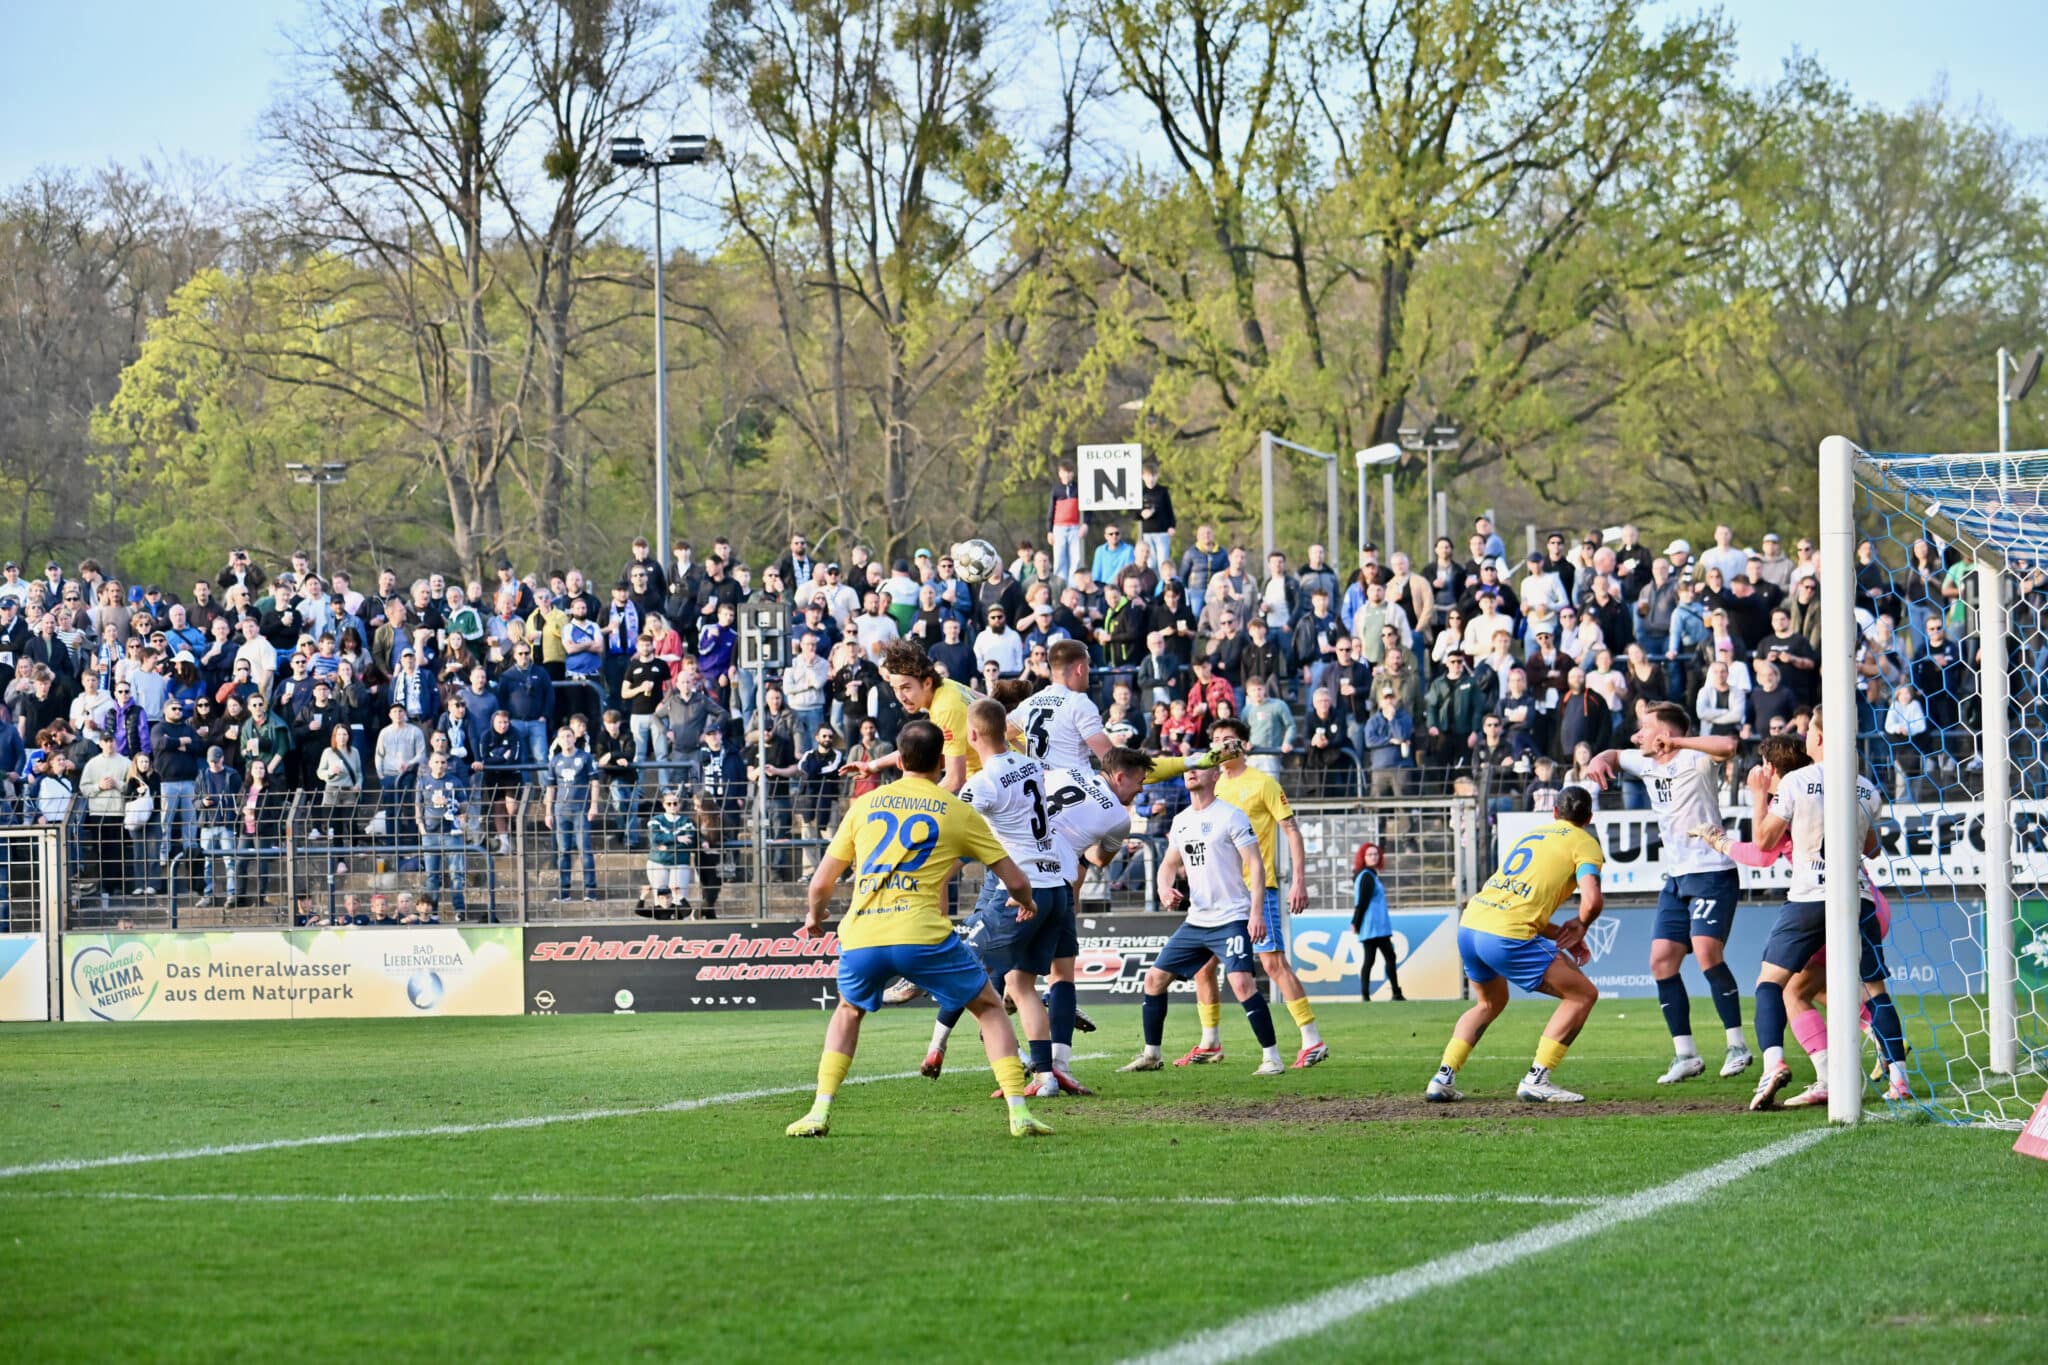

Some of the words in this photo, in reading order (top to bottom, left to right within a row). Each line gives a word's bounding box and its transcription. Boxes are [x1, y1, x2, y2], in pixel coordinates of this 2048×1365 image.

[1086, 449, 1132, 460] BLOCK
[1093, 467, 1127, 503] N
[869, 795, 948, 816] LUCKENWALDE
[1023, 778, 1049, 841] 3
[860, 810, 940, 877] 29
[1189, 854, 1206, 867] LY!
[1503, 834, 1546, 877] 6
[1692, 898, 1717, 920] 27
[413, 944, 434, 955] BAD
[1225, 935, 1244, 958] 20
[83, 951, 135, 980] Regional
[166, 962, 201, 979] Das
[207, 960, 352, 978] Mineralwasser
[89, 965, 144, 996] KLIMA
[97, 985, 145, 1008] NEUTRAL
[164, 987, 197, 1002] aus
[204, 985, 246, 1001] dem
[252, 983, 354, 1004] Naturpark
[690, 996, 757, 1005] VOLVO
